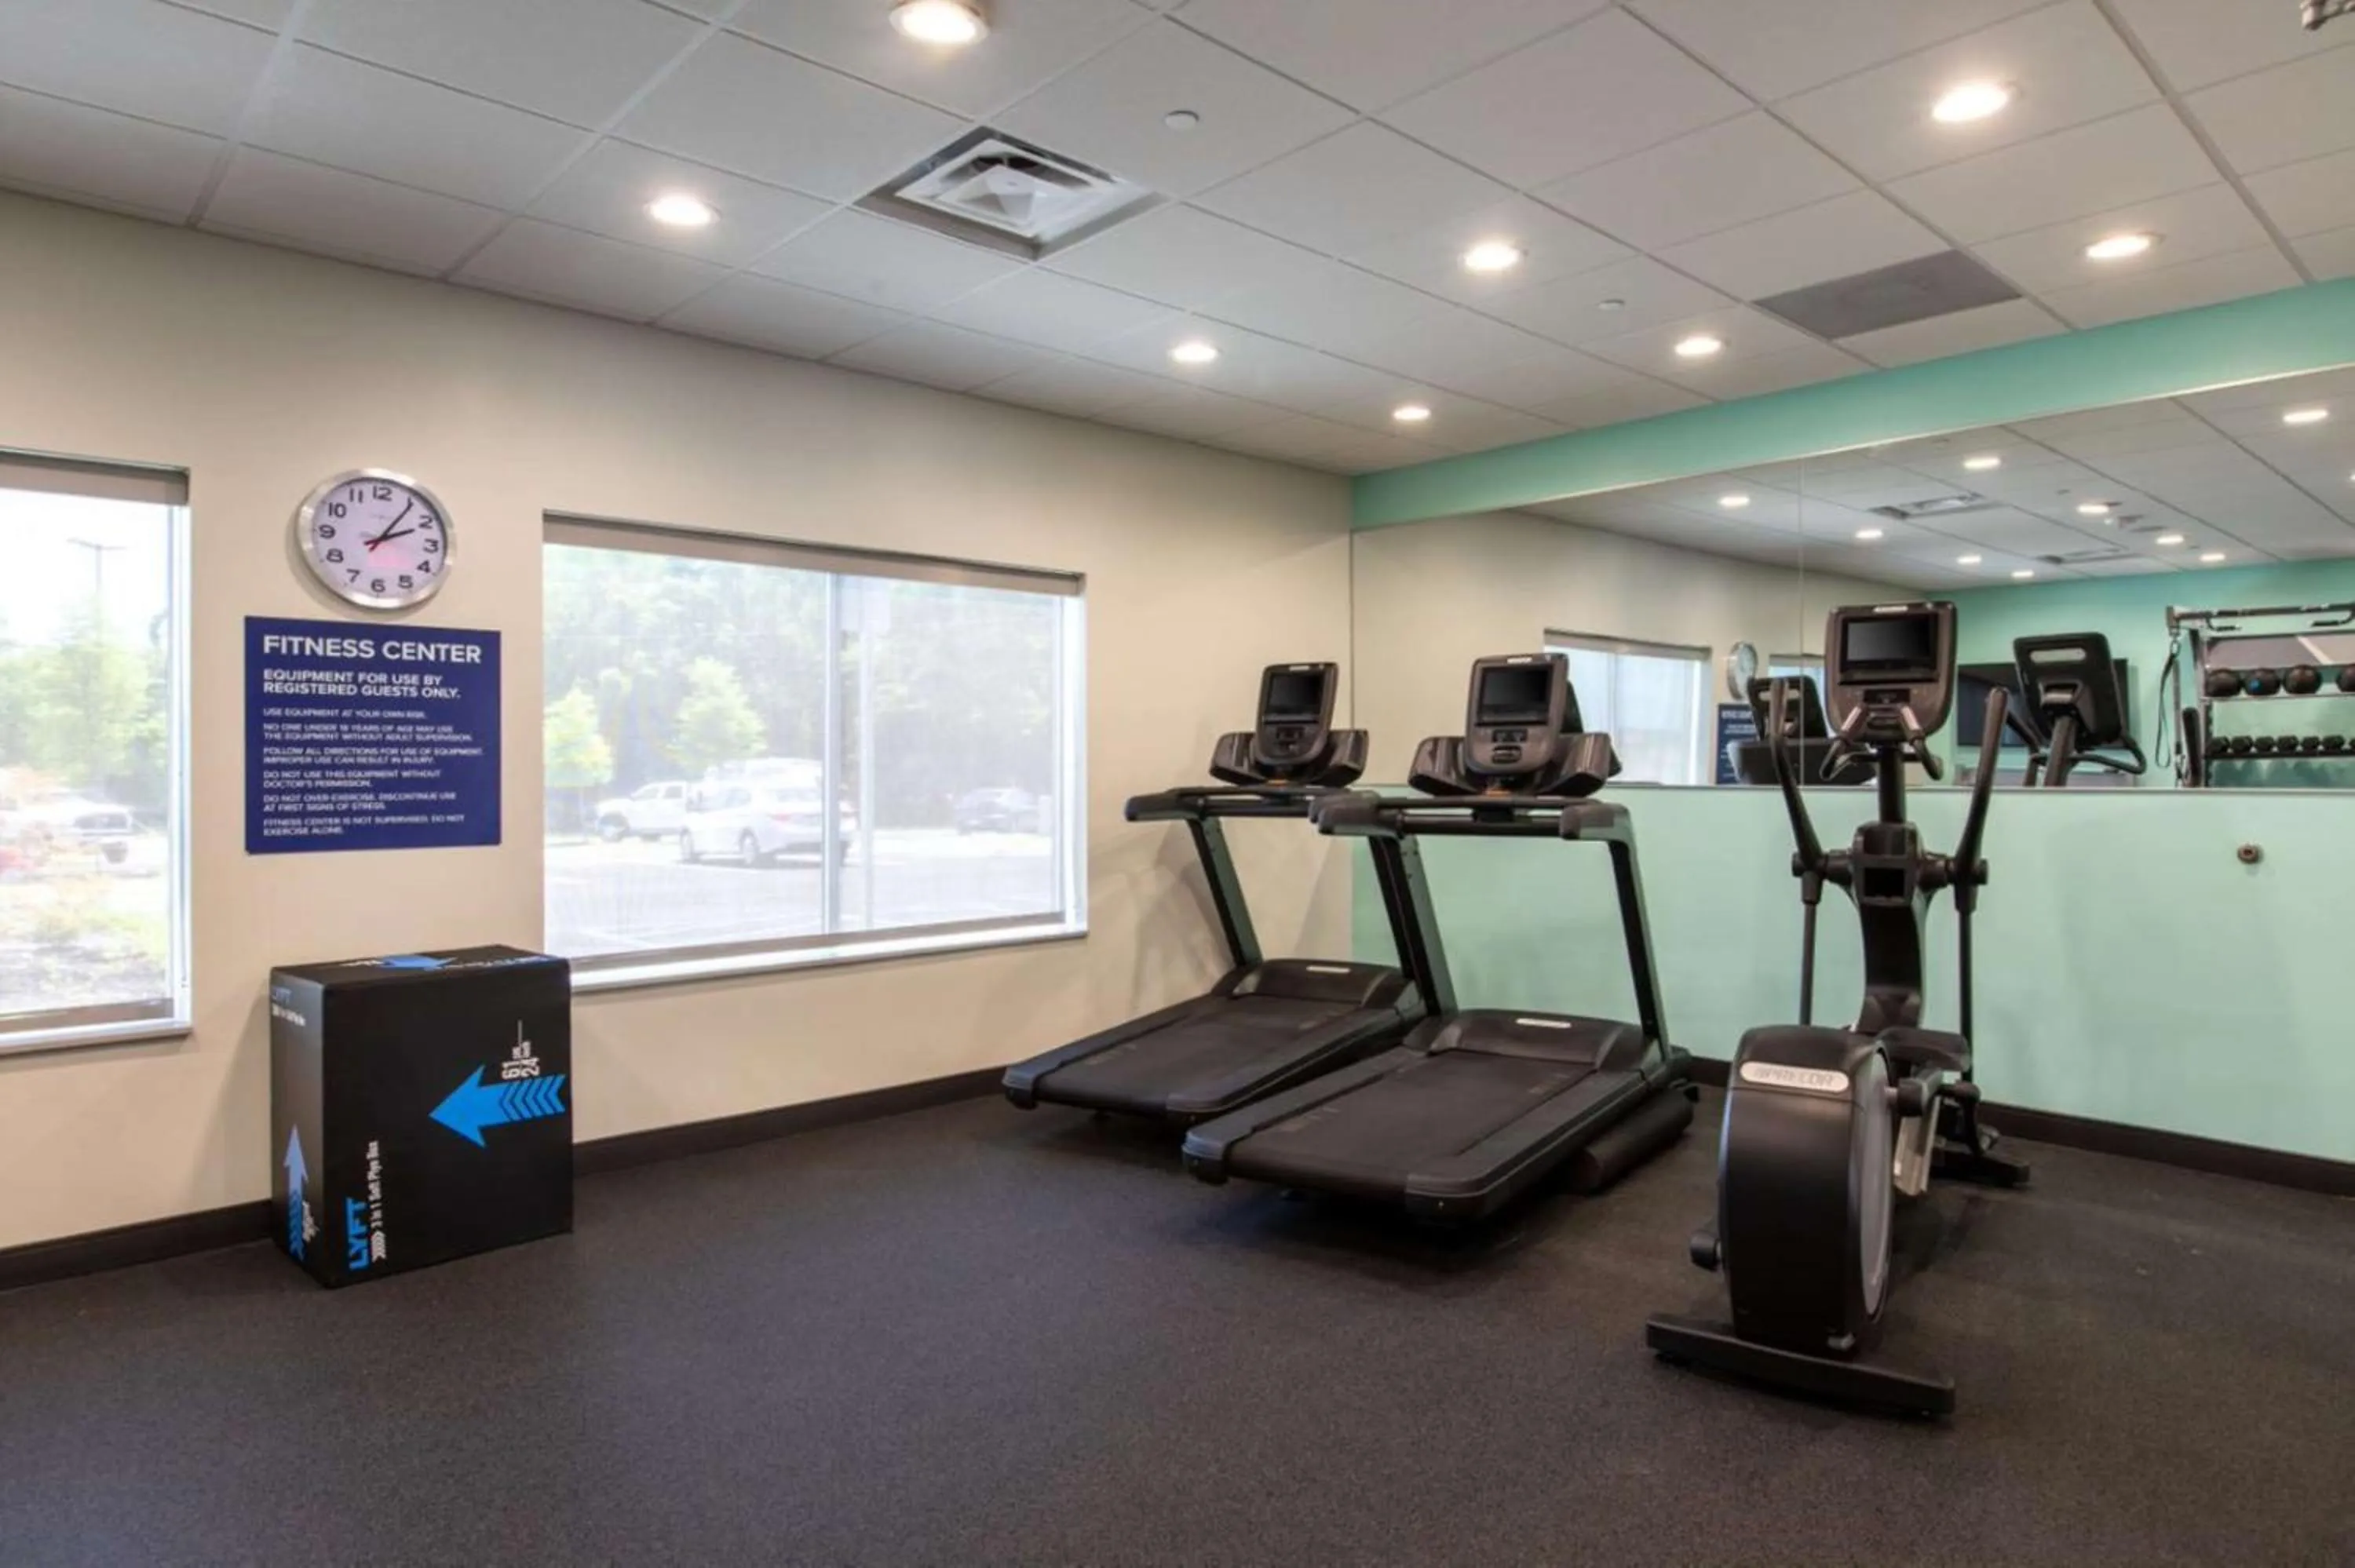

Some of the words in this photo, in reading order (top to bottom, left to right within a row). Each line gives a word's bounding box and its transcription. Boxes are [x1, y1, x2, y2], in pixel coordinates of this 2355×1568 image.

[349, 488, 363, 503] 11
[372, 485, 392, 501] 12
[328, 502, 347, 519] 10
[418, 515, 433, 529] 2
[319, 524, 336, 539] 9
[423, 538, 439, 553] 3
[326, 548, 344, 563] 8
[416, 560, 431, 573] 4
[346, 568, 360, 583] 7
[398, 574, 414, 589] 5
[371, 578, 386, 593] 6
[264, 635, 375, 658] FITNESS
[382, 641, 481, 663] CENTER
[264, 669, 353, 684] EQUIPMENT
[358, 672, 388, 684] FOR
[392, 673, 419, 685] USE
[424, 674, 443, 686] BY
[264, 683, 357, 696] REGISTERED
[362, 684, 418, 698] GUESTS
[422, 687, 461, 699] ONLY.
[264, 708, 282, 717] USE
[285, 708, 339, 717] EQUIPMENT
[356, 709, 380, 717] YOUR
[502, 1061, 520, 1080] 61
[520, 1056, 540, 1078] 24
[345, 1196, 370, 1270] LYFT
